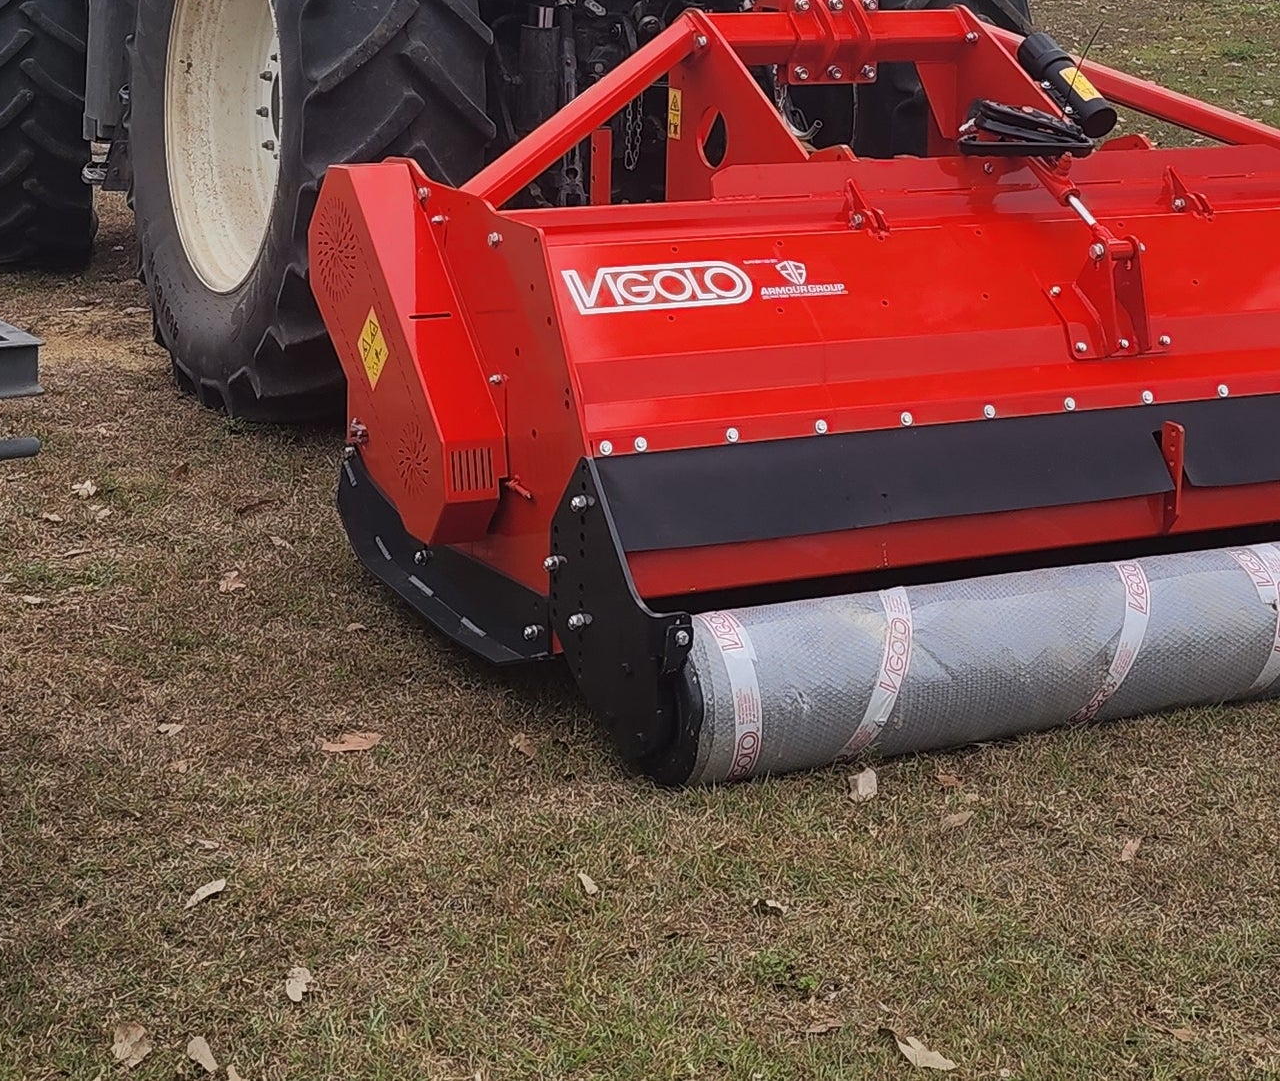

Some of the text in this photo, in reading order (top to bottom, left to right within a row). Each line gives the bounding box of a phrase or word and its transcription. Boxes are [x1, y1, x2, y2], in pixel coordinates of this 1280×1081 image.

[561, 260, 753, 315] VIGOLO
[760, 285, 807, 296] ARMOUR
[807, 283, 846, 294] GROUP
[1119, 563, 1147, 615] VIGOLO
[879, 617, 911, 694] VIGOLO
